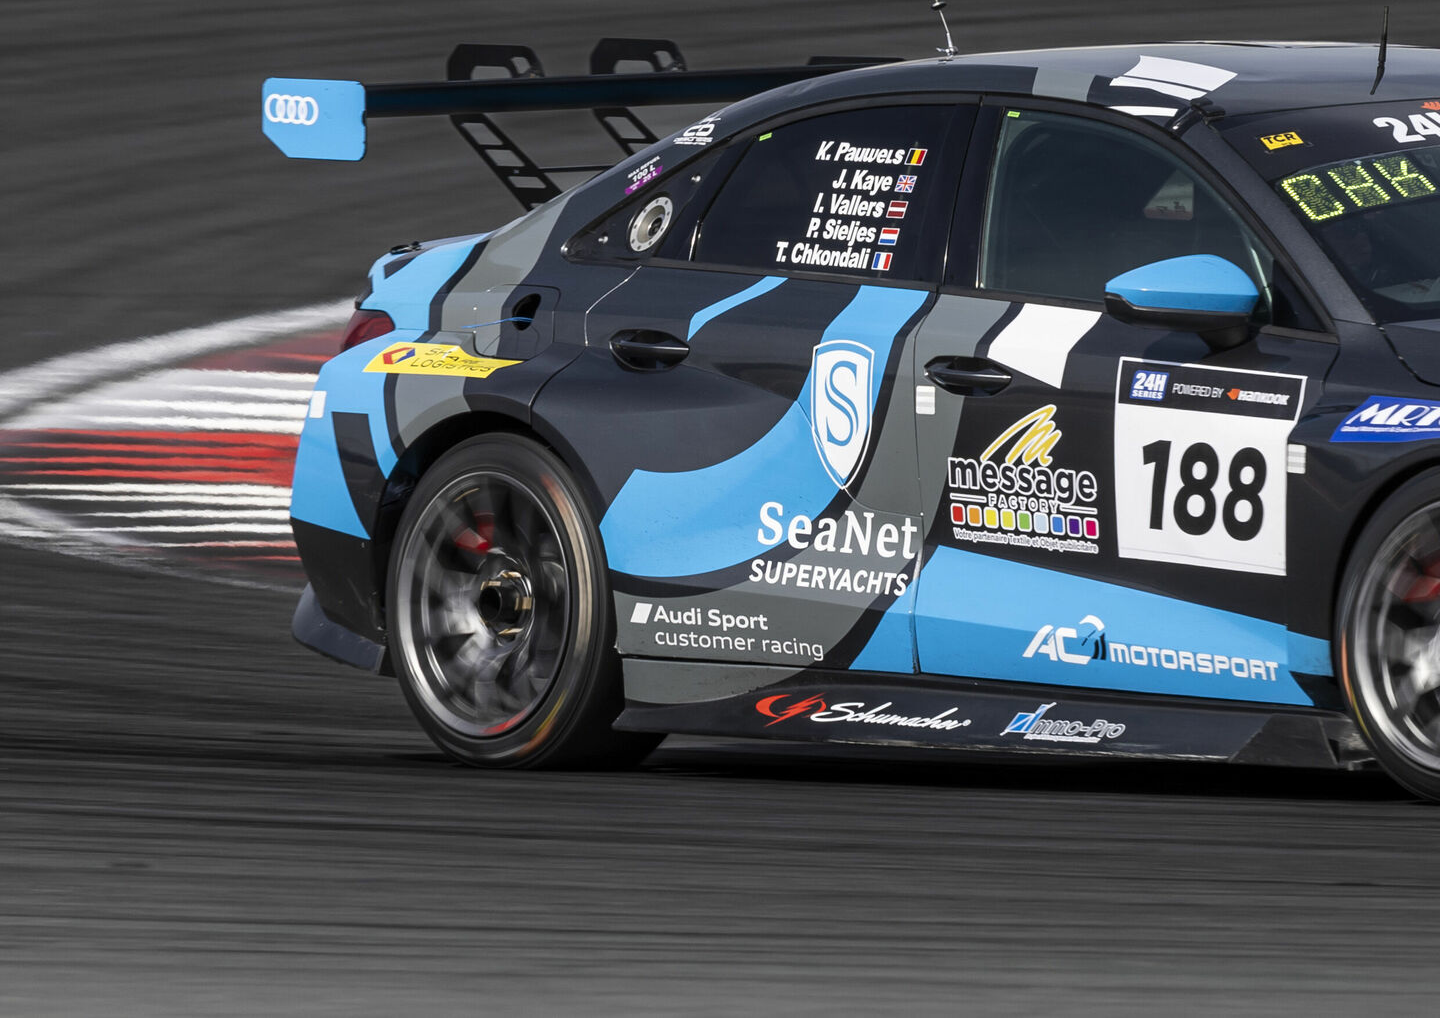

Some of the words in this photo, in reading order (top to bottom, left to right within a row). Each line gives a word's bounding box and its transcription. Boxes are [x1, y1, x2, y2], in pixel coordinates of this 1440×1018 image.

[815, 141, 831, 160] K.
[1263, 133, 1297, 144] TCR
[632, 169, 648, 182] 100
[832, 169, 847, 189] J.
[850, 170, 893, 195] Kaye
[813, 193, 824, 213] I.
[830, 194, 885, 218] Vallers
[806, 218, 820, 238] P.
[823, 219, 877, 246] Sieljes
[776, 241, 789, 262] T.
[791, 243, 870, 269] Chkondali
[1132, 389, 1163, 400] SERIES
[1133, 372, 1167, 393] 24H
[1172, 383, 1211, 399] POWERED
[1211, 387, 1224, 399] BY
[948, 457, 1097, 505] message
[1142, 439, 1267, 542] 188
[988, 493, 1058, 513] FACTORY
[757, 501, 918, 559] SeaNet
[953, 527, 972, 540] Votre
[972, 531, 1008, 544] partenaire
[1008, 534, 1031, 547] Textile
[1031, 538, 1040, 547] et
[1040, 539, 1059, 551] Objet
[1059, 541, 1099, 554] publicitaire
[749, 558, 908, 596] SUPERYACHTS
[653, 605, 702, 625] Audi
[707, 609, 769, 632] Sport
[655, 631, 753, 651] customer
[762, 638, 824, 661] racing
[1022, 624, 1092, 665] AC
[1109, 642, 1279, 681] MOTORSPORT
